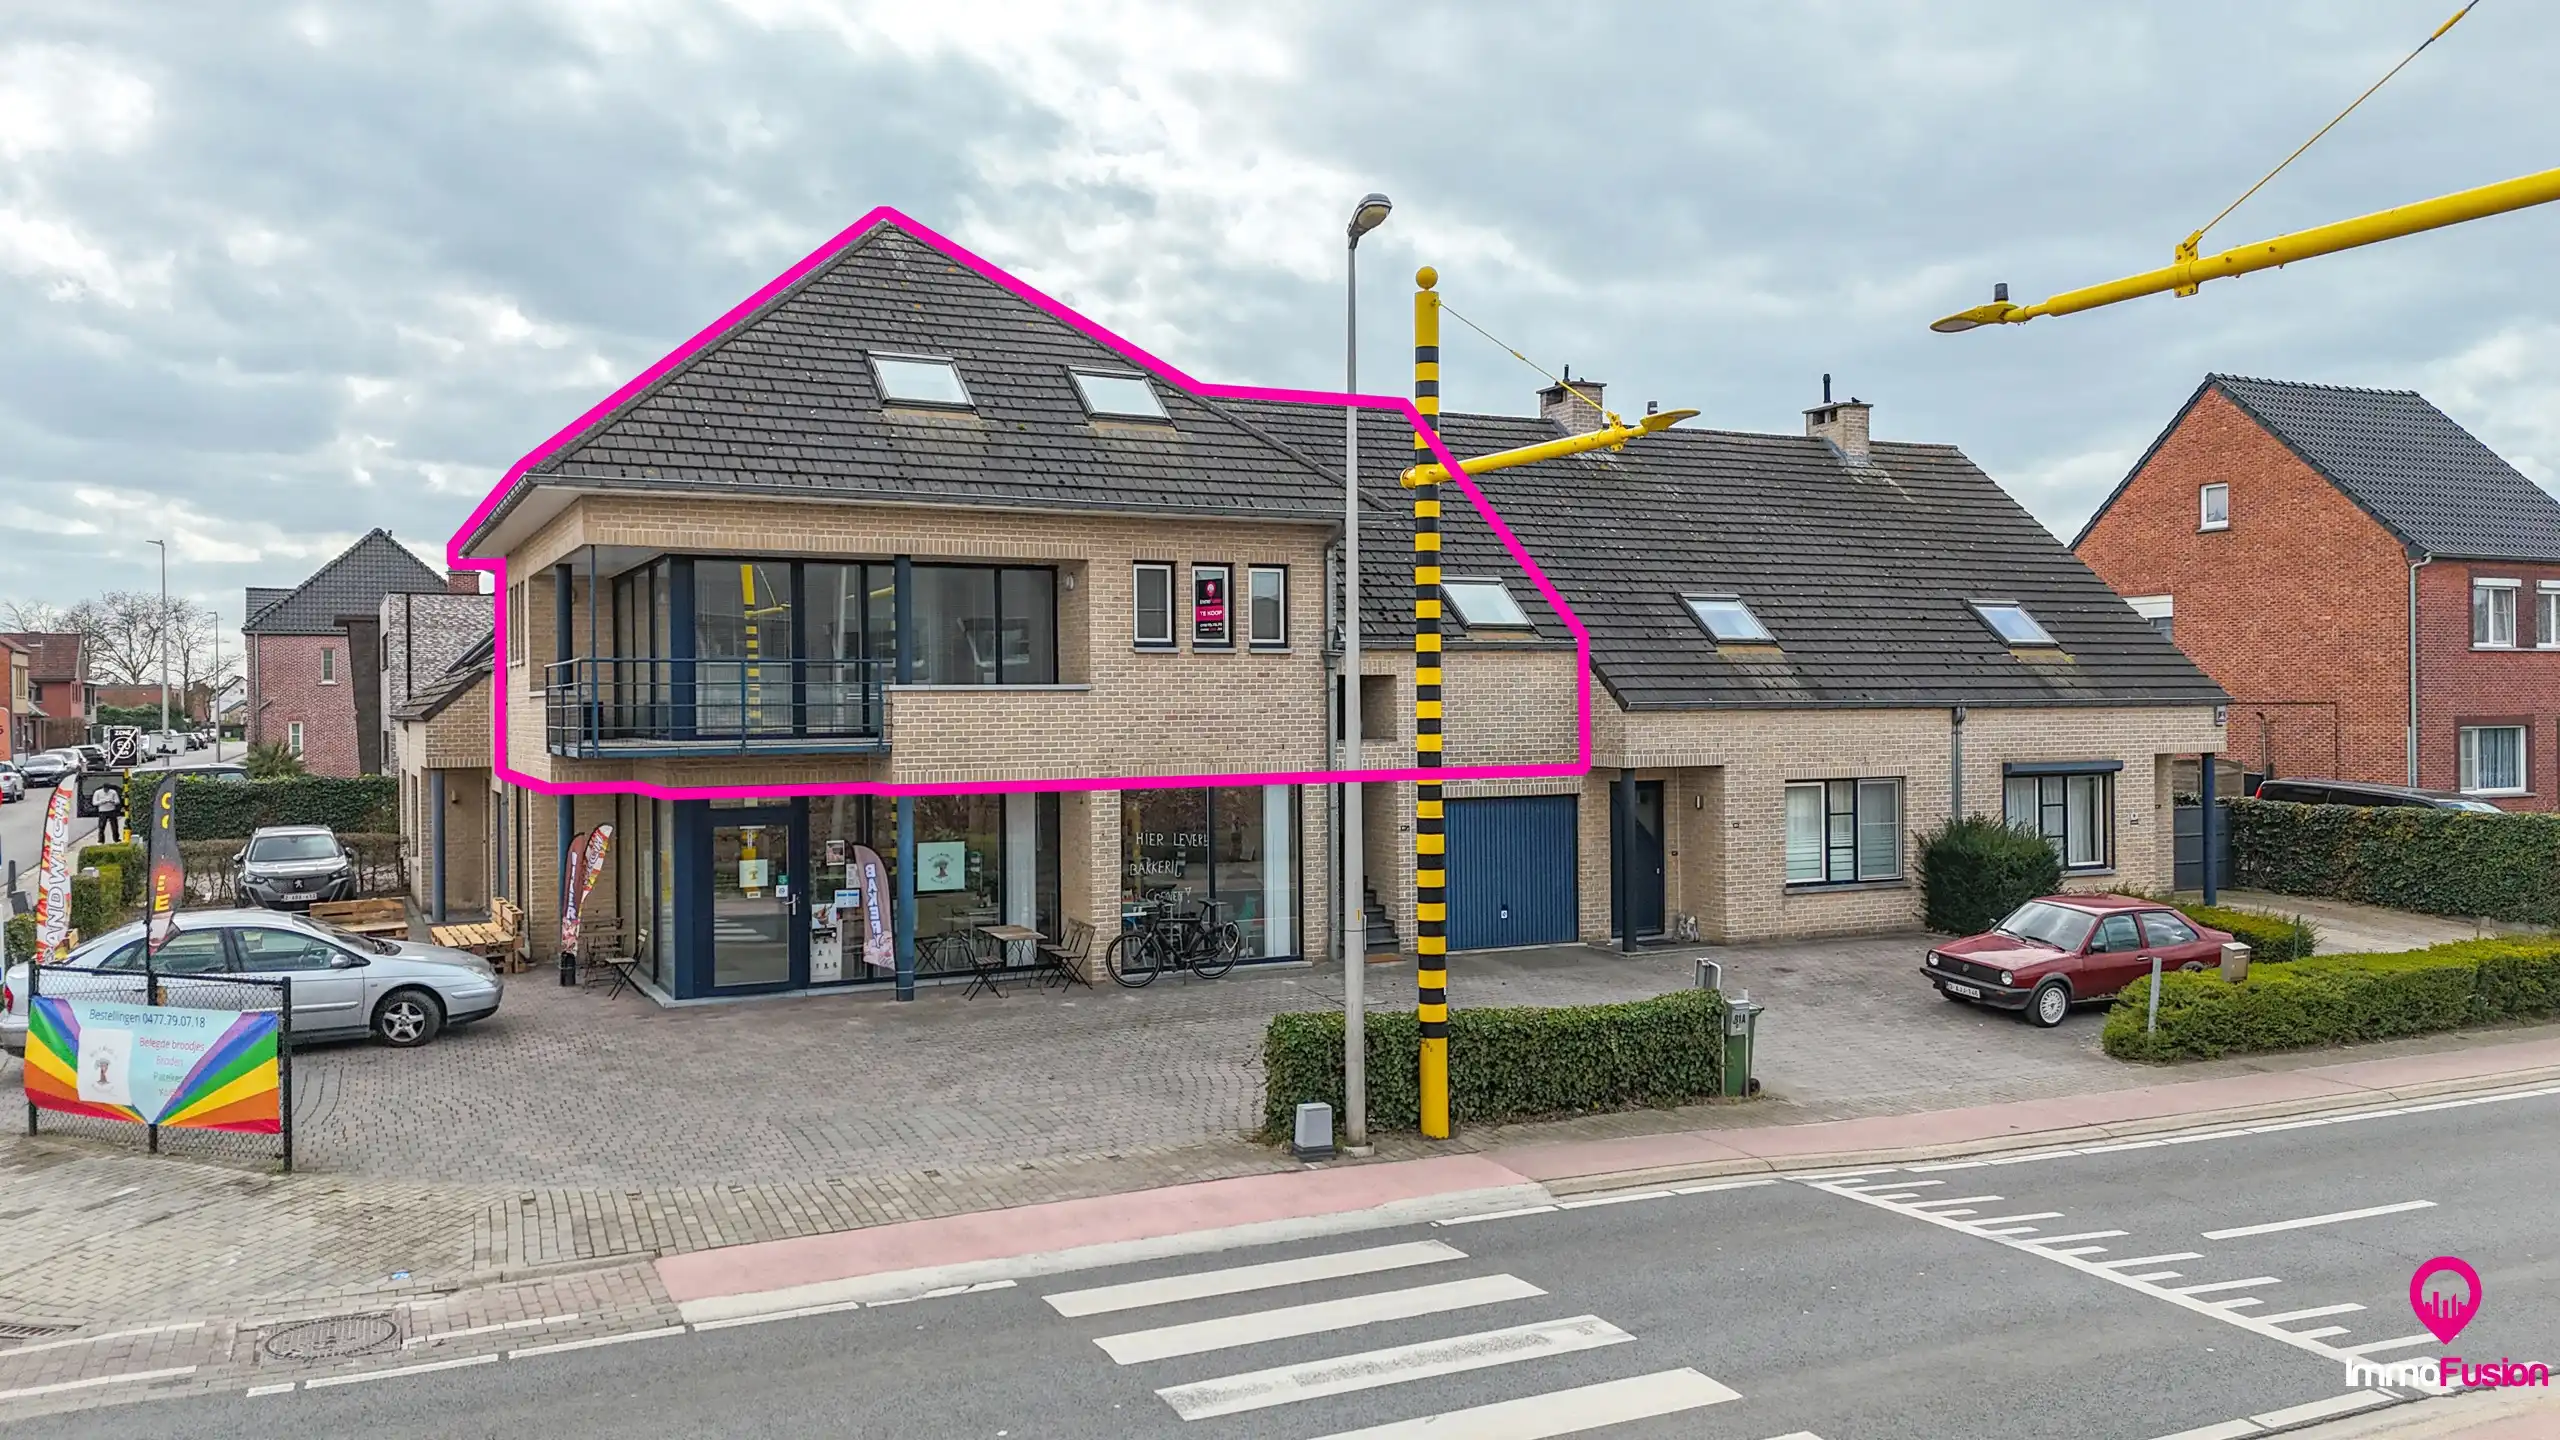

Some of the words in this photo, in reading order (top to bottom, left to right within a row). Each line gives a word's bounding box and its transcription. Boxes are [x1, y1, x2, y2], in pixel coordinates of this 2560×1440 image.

[1136, 830, 1164, 846] HIER
[1130, 860, 1182, 878] BAKKERIJ
[89, 1009, 140, 1026] Bestellingen
[142, 1012, 206, 1028] 0477.79.07.18
[140, 1037, 170, 1052] Belegde
[172, 1040, 205, 1054] broodjes
